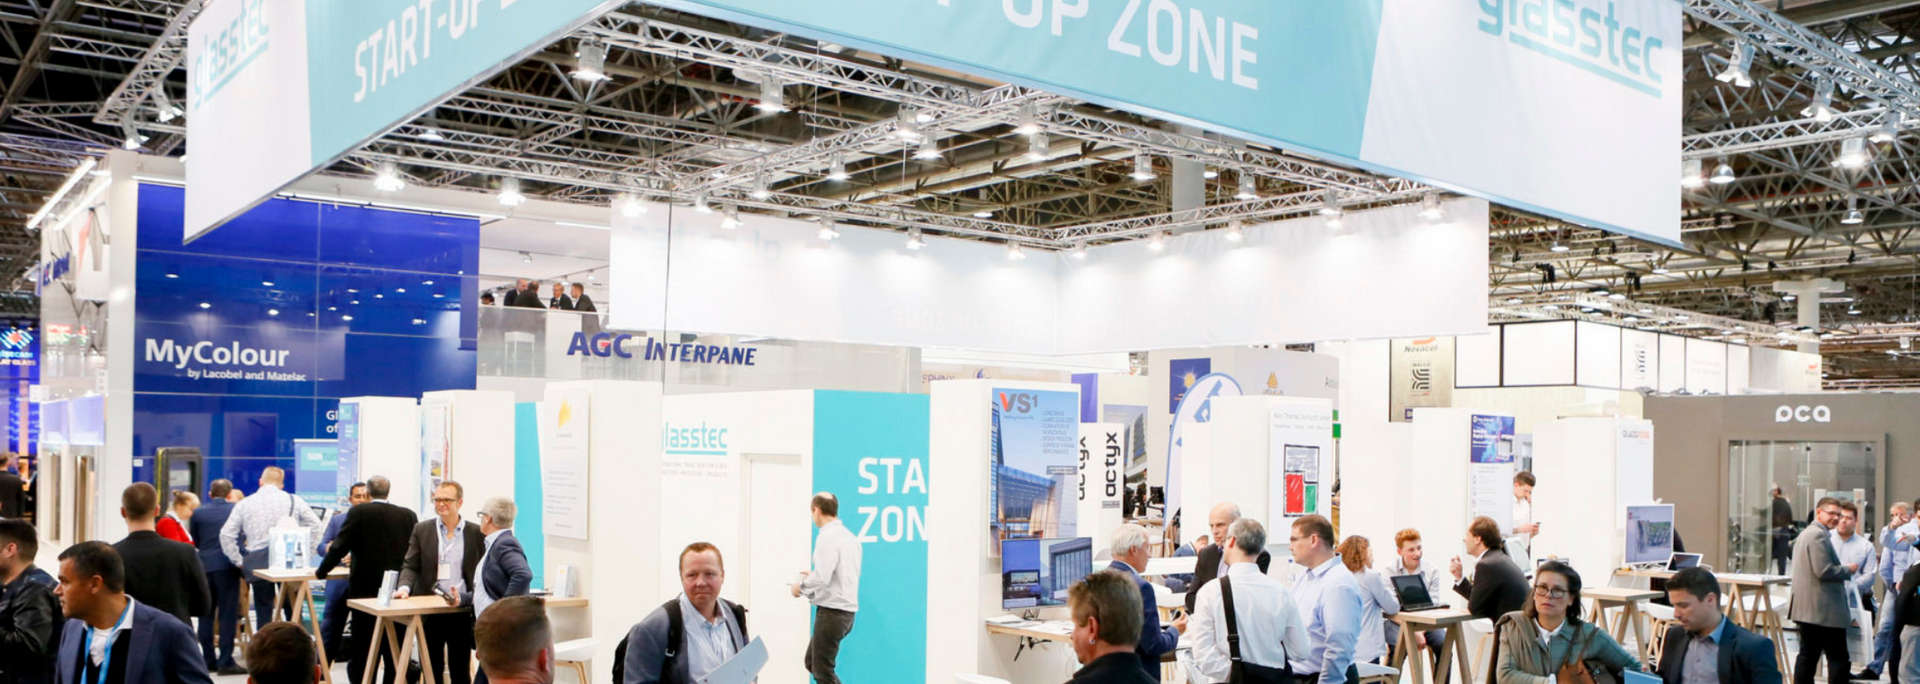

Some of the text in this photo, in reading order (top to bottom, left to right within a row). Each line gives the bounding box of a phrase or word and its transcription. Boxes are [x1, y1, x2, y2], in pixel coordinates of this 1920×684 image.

[1108, 0, 1259, 91] ZONE
[145, 338, 290, 369] MyColour
[566, 331, 633, 358] AGC
[1404, 345, 1438, 353] Novacel
[187, 368, 307, 382] by Lacobel and Matelac
[661, 421, 728, 451] lasstec
[858, 456, 927, 495] STA
[1104, 431, 1121, 497] actyx
[858, 505, 929, 543] ZON
